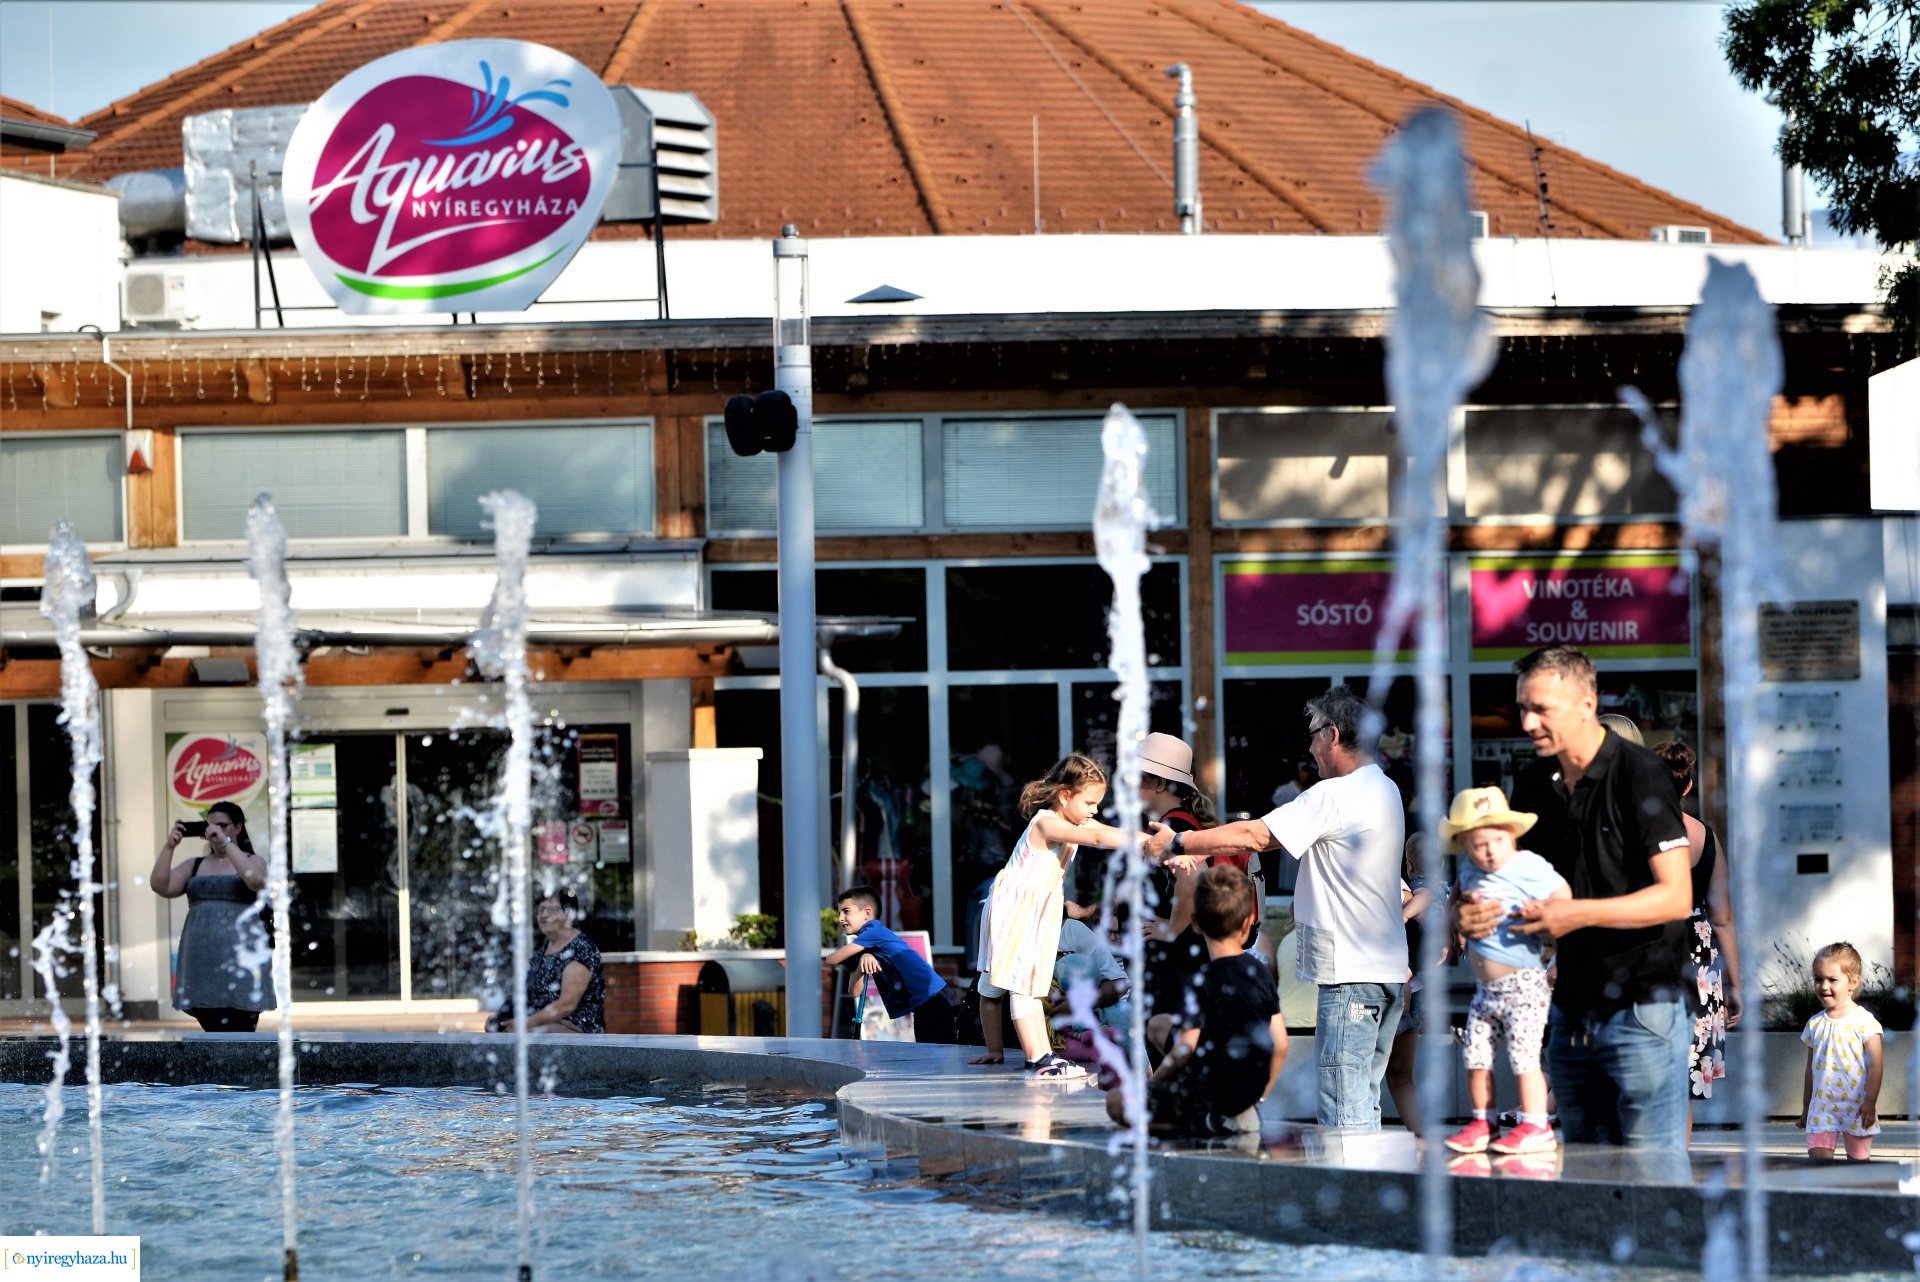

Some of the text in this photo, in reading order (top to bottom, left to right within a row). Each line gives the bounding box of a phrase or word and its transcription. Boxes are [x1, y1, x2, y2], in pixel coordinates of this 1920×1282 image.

[308, 122, 588, 277] Aquarius
[412, 194, 581, 218] NYÍREGYHÁZA
[1522, 573, 1634, 599] VINOTÉKA
[1296, 599, 1373, 626] SÓSTÓ
[1570, 599, 1588, 620] &
[1526, 621, 1639, 642] SOUVENIR
[174, 752, 262, 801] Aquarius
